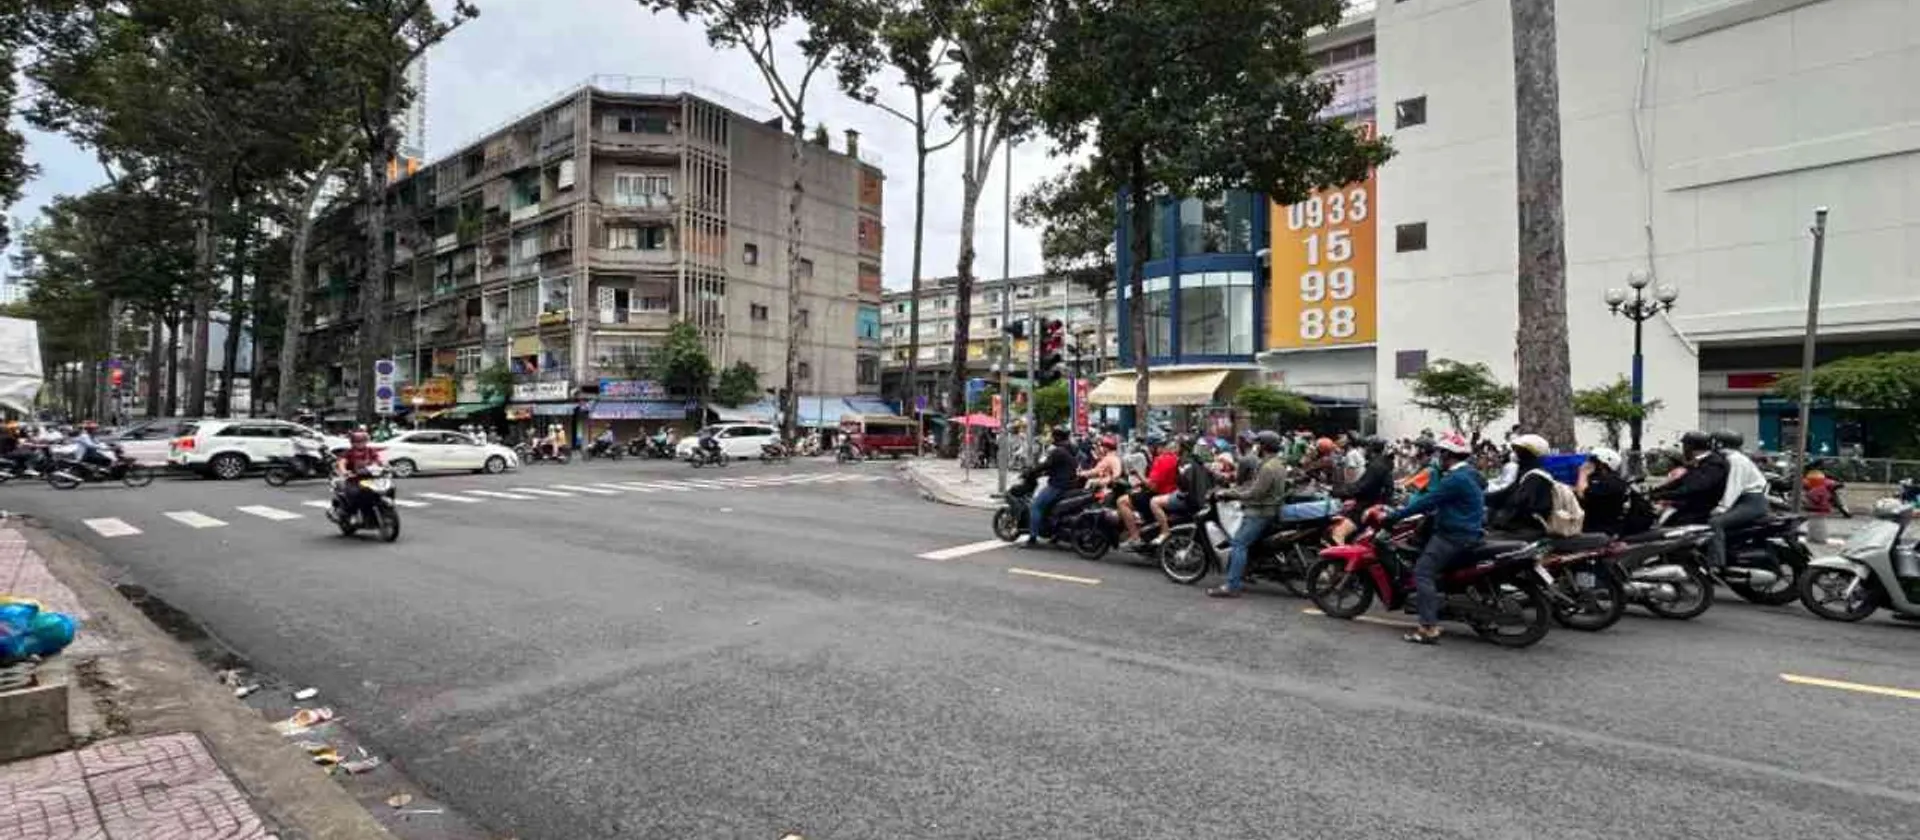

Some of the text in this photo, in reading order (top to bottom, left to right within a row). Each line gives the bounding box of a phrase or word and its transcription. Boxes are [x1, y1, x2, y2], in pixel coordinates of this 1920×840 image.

[1287, 187, 1369, 230] 0933
[1303, 228, 1353, 265] 15
[1300, 267, 1355, 302] 99
[1300, 305, 1357, 340] 88
